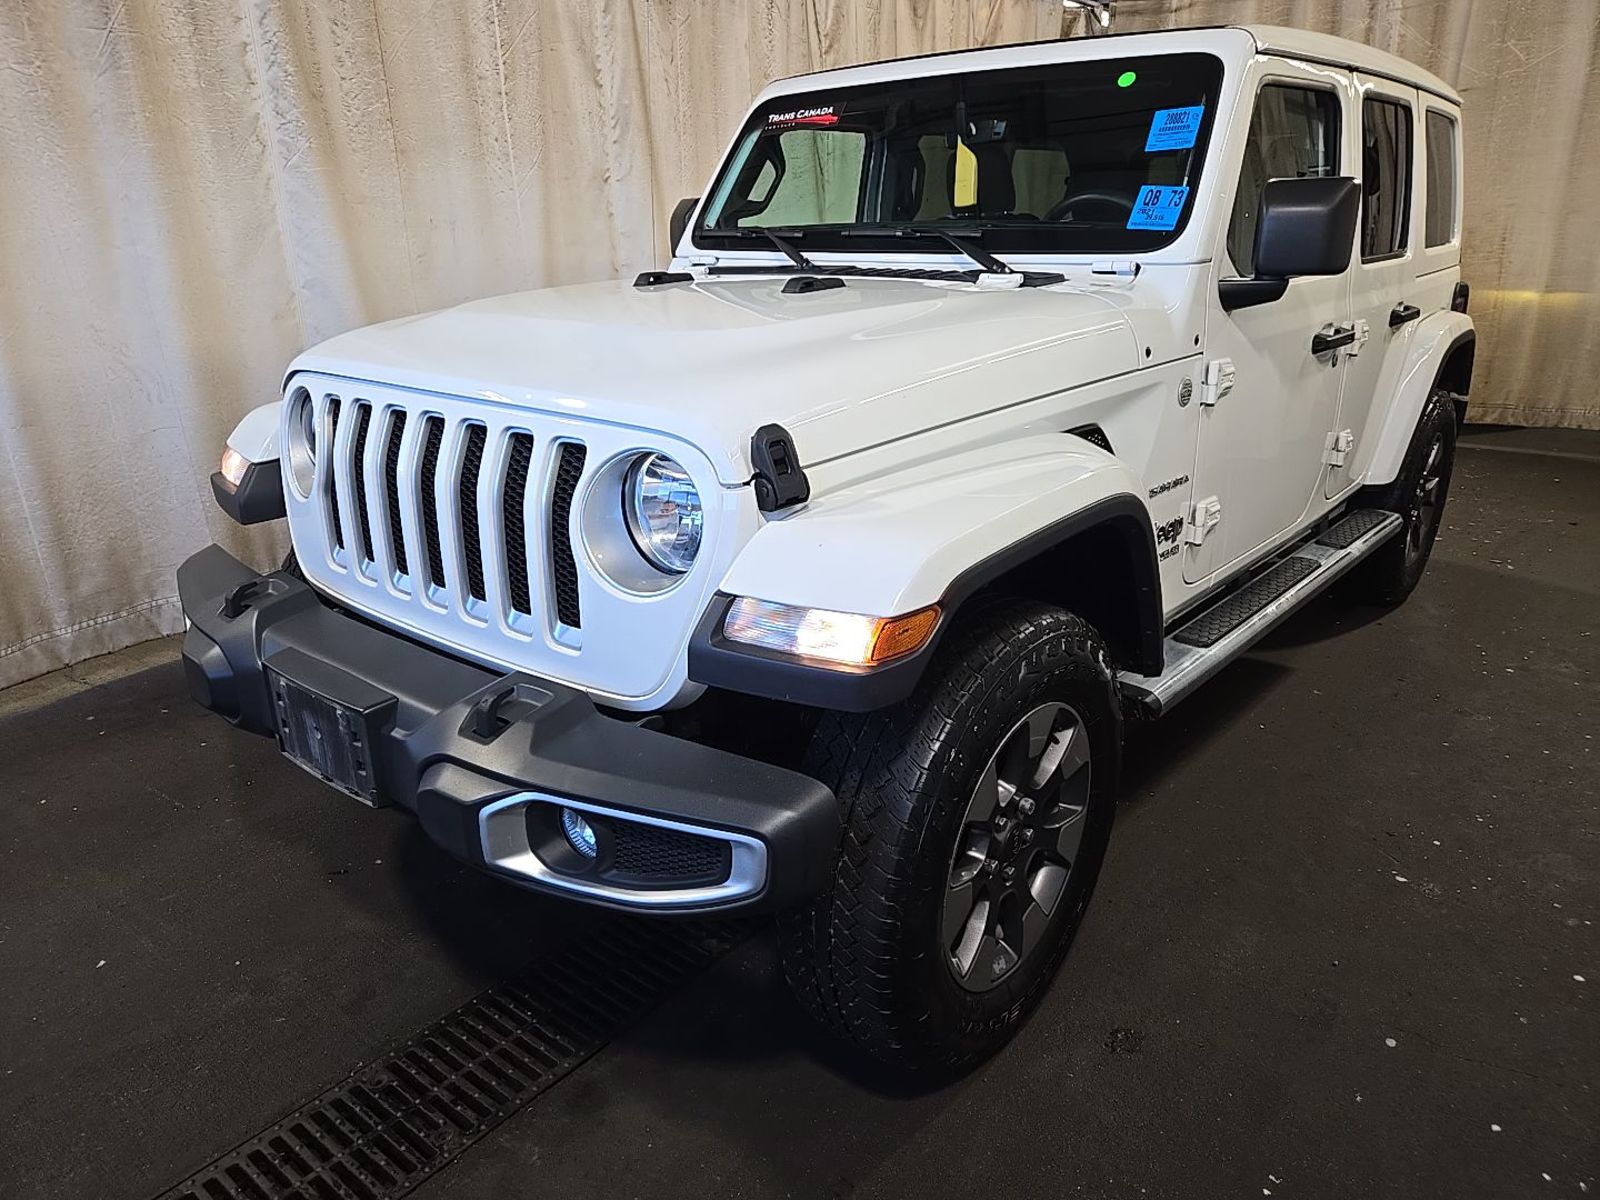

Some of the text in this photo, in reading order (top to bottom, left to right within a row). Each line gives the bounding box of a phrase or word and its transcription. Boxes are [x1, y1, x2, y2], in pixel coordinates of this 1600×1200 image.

[768, 106, 833, 122] TRANS CANADA
[1143, 189, 1185, 207] QB 73
